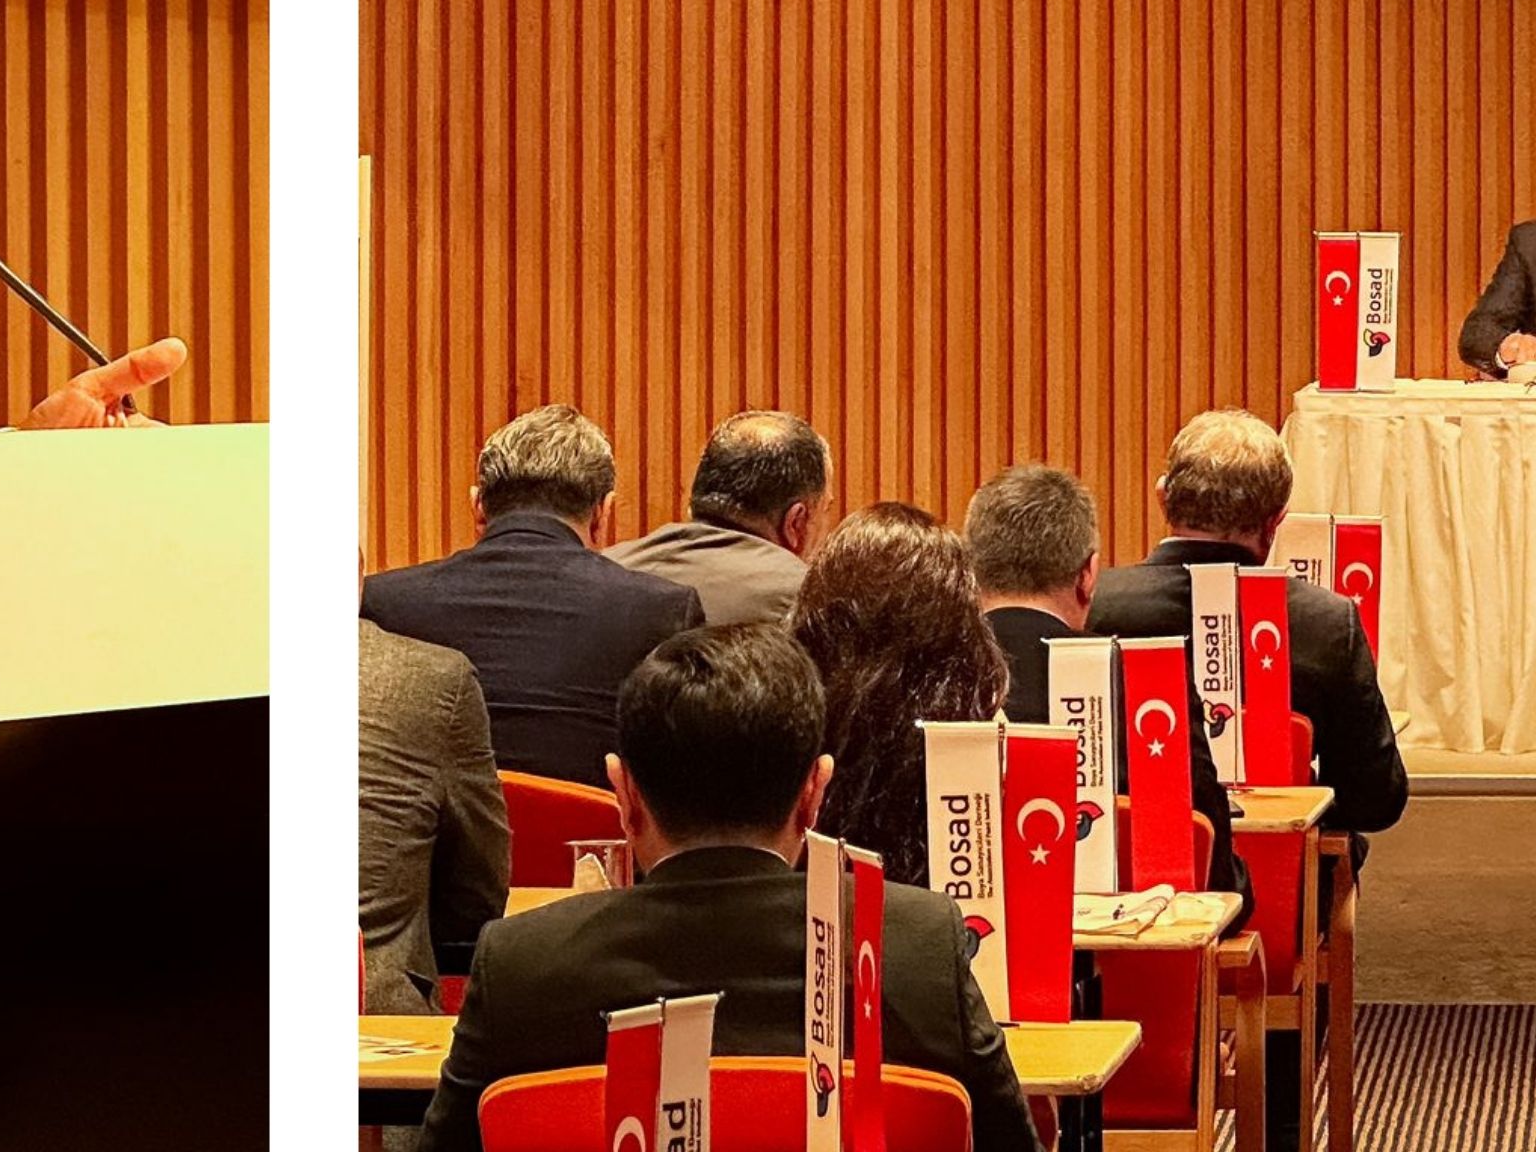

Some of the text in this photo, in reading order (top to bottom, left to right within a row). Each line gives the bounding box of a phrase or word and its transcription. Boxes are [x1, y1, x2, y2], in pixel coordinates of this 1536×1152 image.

[1366, 268, 1382, 324] Bosad
[1200, 615, 1221, 692] Bosad
[940, 794, 972, 900] Bosad
[811, 916, 825, 1045] Bosad
